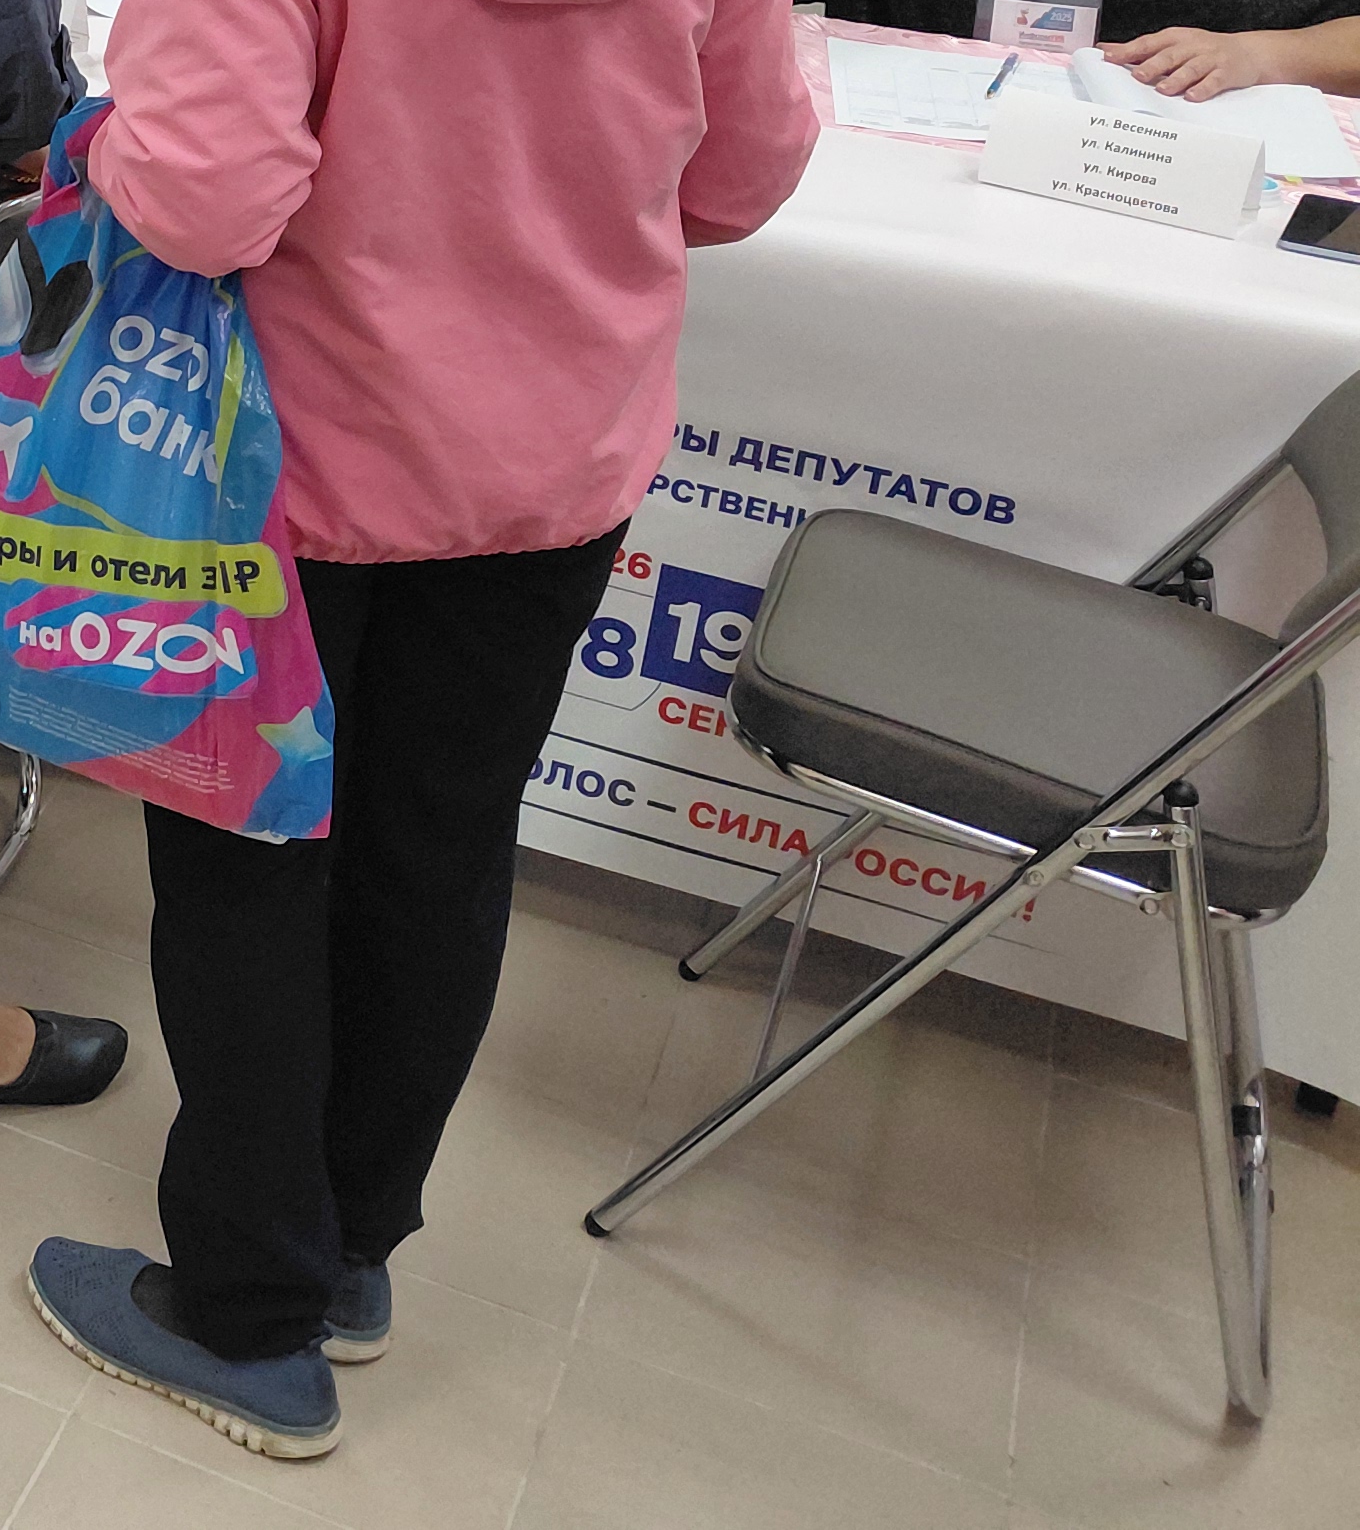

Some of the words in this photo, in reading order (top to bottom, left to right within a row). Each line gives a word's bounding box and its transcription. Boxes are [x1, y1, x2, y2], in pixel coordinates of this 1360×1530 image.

[1090, 116, 1109, 127] ул.
[1113, 119, 1178, 140] Весенняя
[1081, 138, 1100, 149] ул.
[1105, 141, 1172, 164] Калинина
[1083, 162, 1102, 174] ул.
[1107, 166, 1157, 185] Кирова
[1052, 179, 1071, 191] ул.
[1076, 183, 1178, 214] Красноцветова
[729, 436, 1016, 525] ДЕПУТАТОВ
[53, 549, 77, 572] и
[18, 620, 63, 652] на
[581, 617, 637, 679] 8
[667, 601, 754, 674] 19
[687, 801, 810, 858] СИЛА
